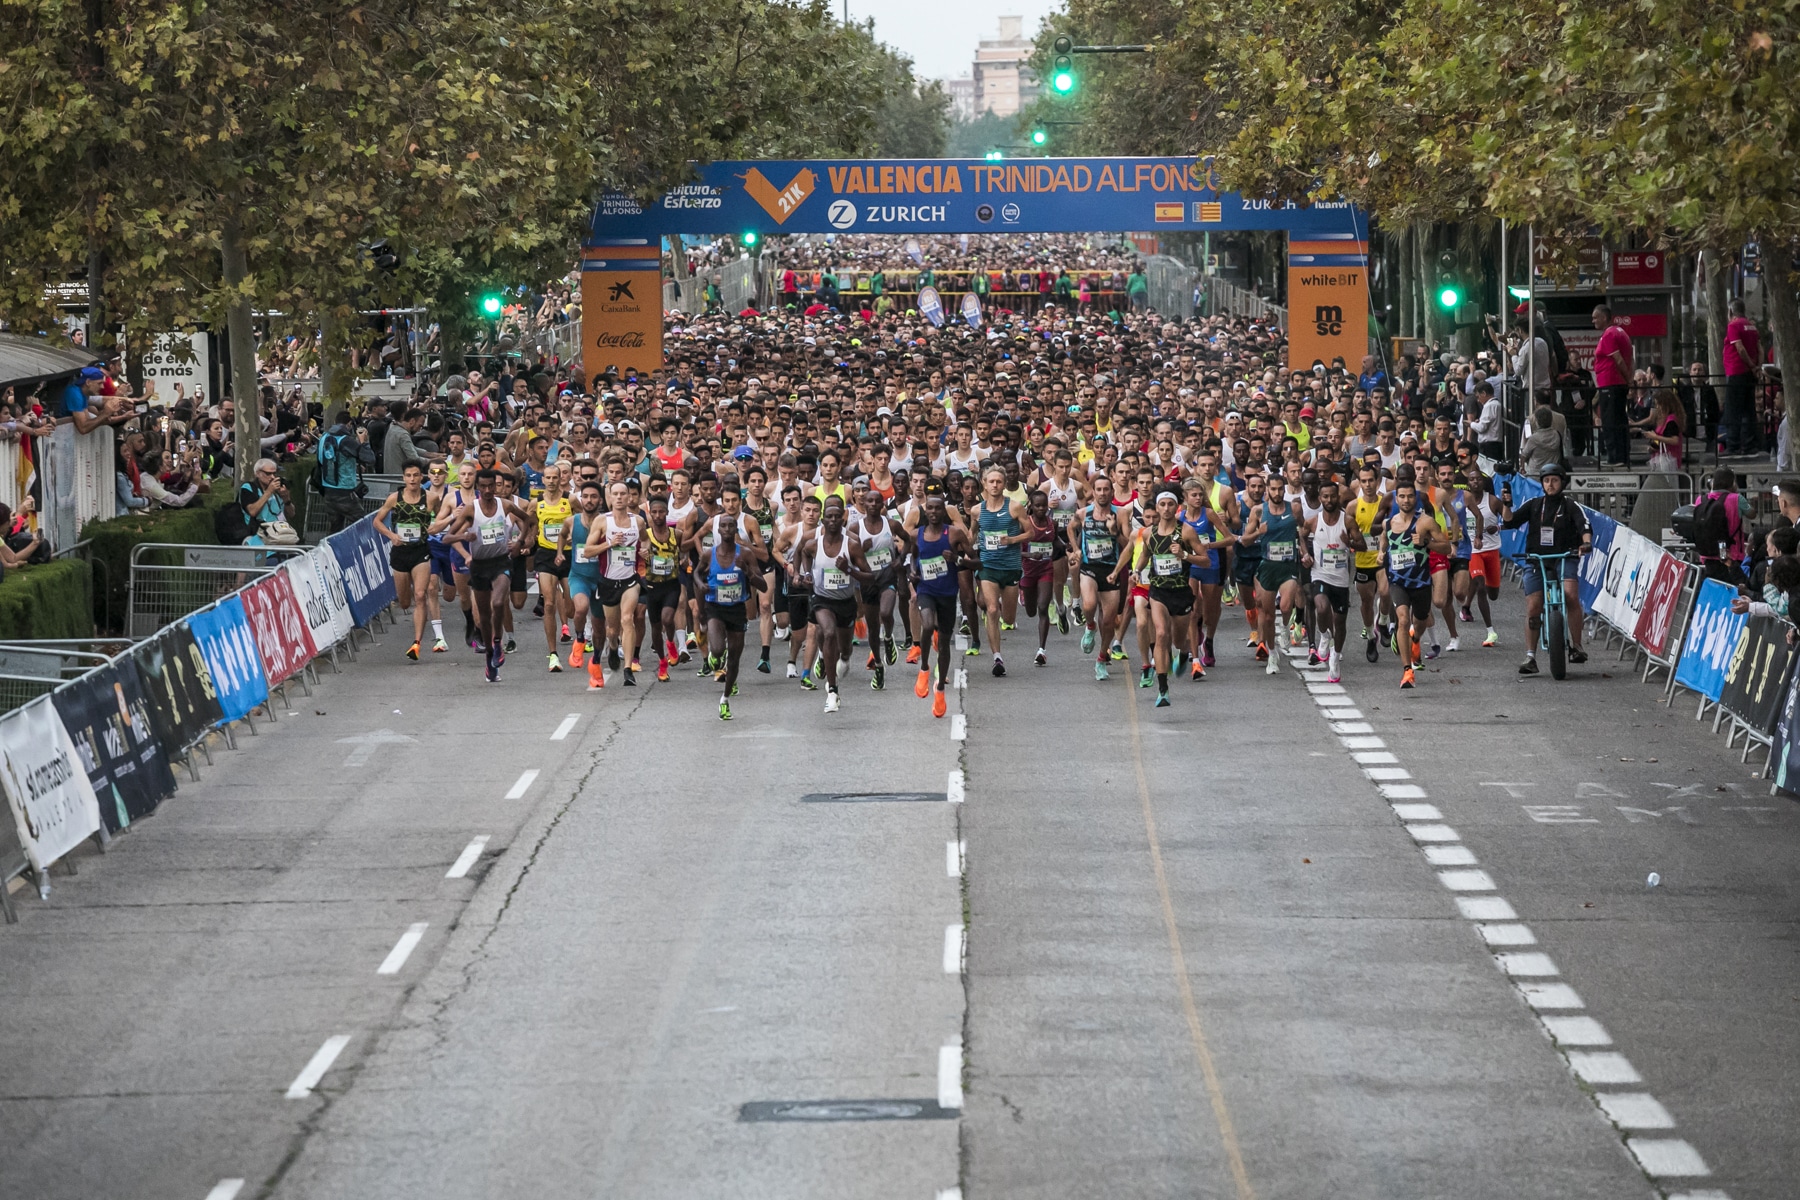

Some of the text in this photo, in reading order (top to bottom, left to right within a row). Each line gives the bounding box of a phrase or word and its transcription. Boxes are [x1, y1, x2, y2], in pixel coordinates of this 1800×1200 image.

[828, 165, 962, 194] VALENCIA
[968, 164, 1092, 193] TRINIDAD
[664, 195, 722, 209] Esfuerzo
[777, 182, 805, 214] 21K
[602, 208, 643, 216] ALFONSO
[867, 205, 945, 223] ZURICH
[1301, 273, 1359, 287] whiteBIT
[601, 303, 641, 313] CaixaBank
[160, 364, 193, 377] más
